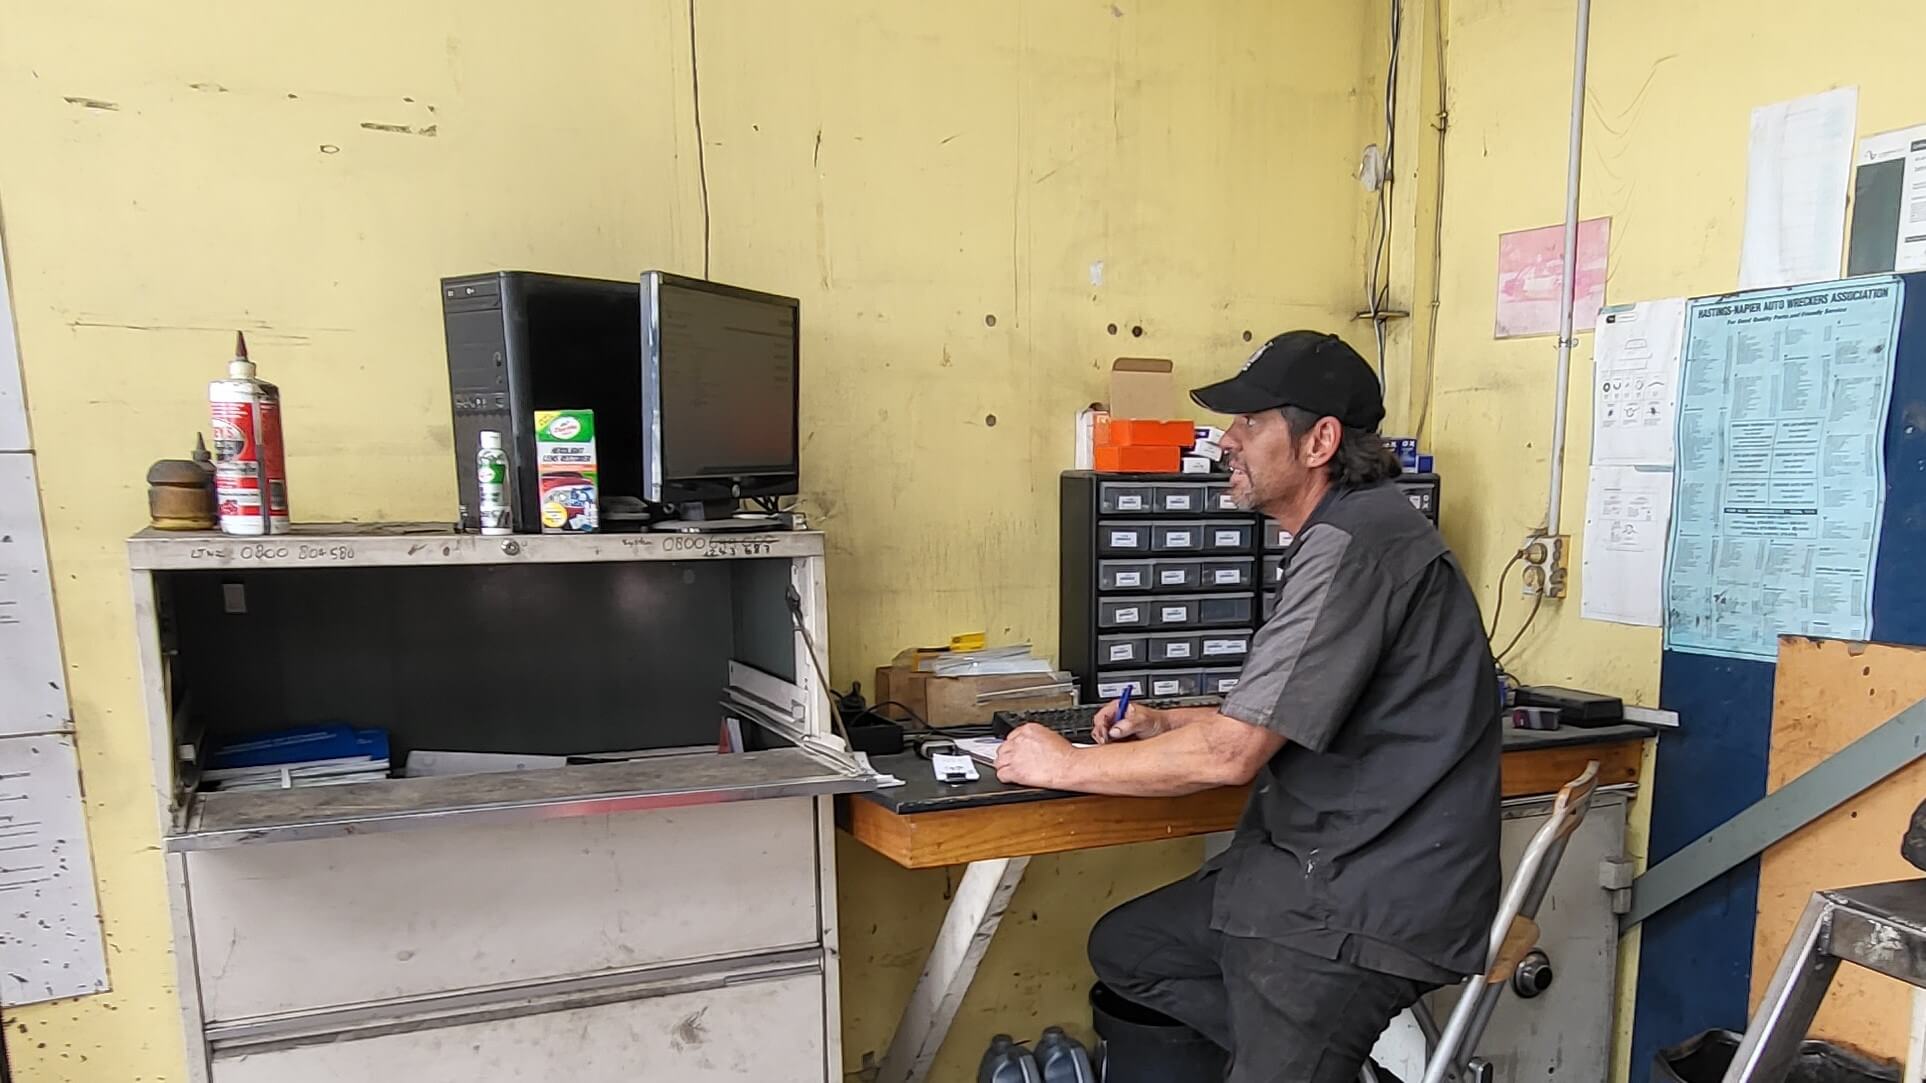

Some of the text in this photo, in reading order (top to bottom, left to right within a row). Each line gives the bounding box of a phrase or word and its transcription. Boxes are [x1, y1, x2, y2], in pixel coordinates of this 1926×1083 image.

[1698, 288, 1888, 318] HASTINGS-NAPIER AUTO WRECKERS ASSOCIATION
[1801, 309, 1823, 317] Friendly
[663, 536, 705, 551] 0800
[240, 544, 289, 559] 0800
